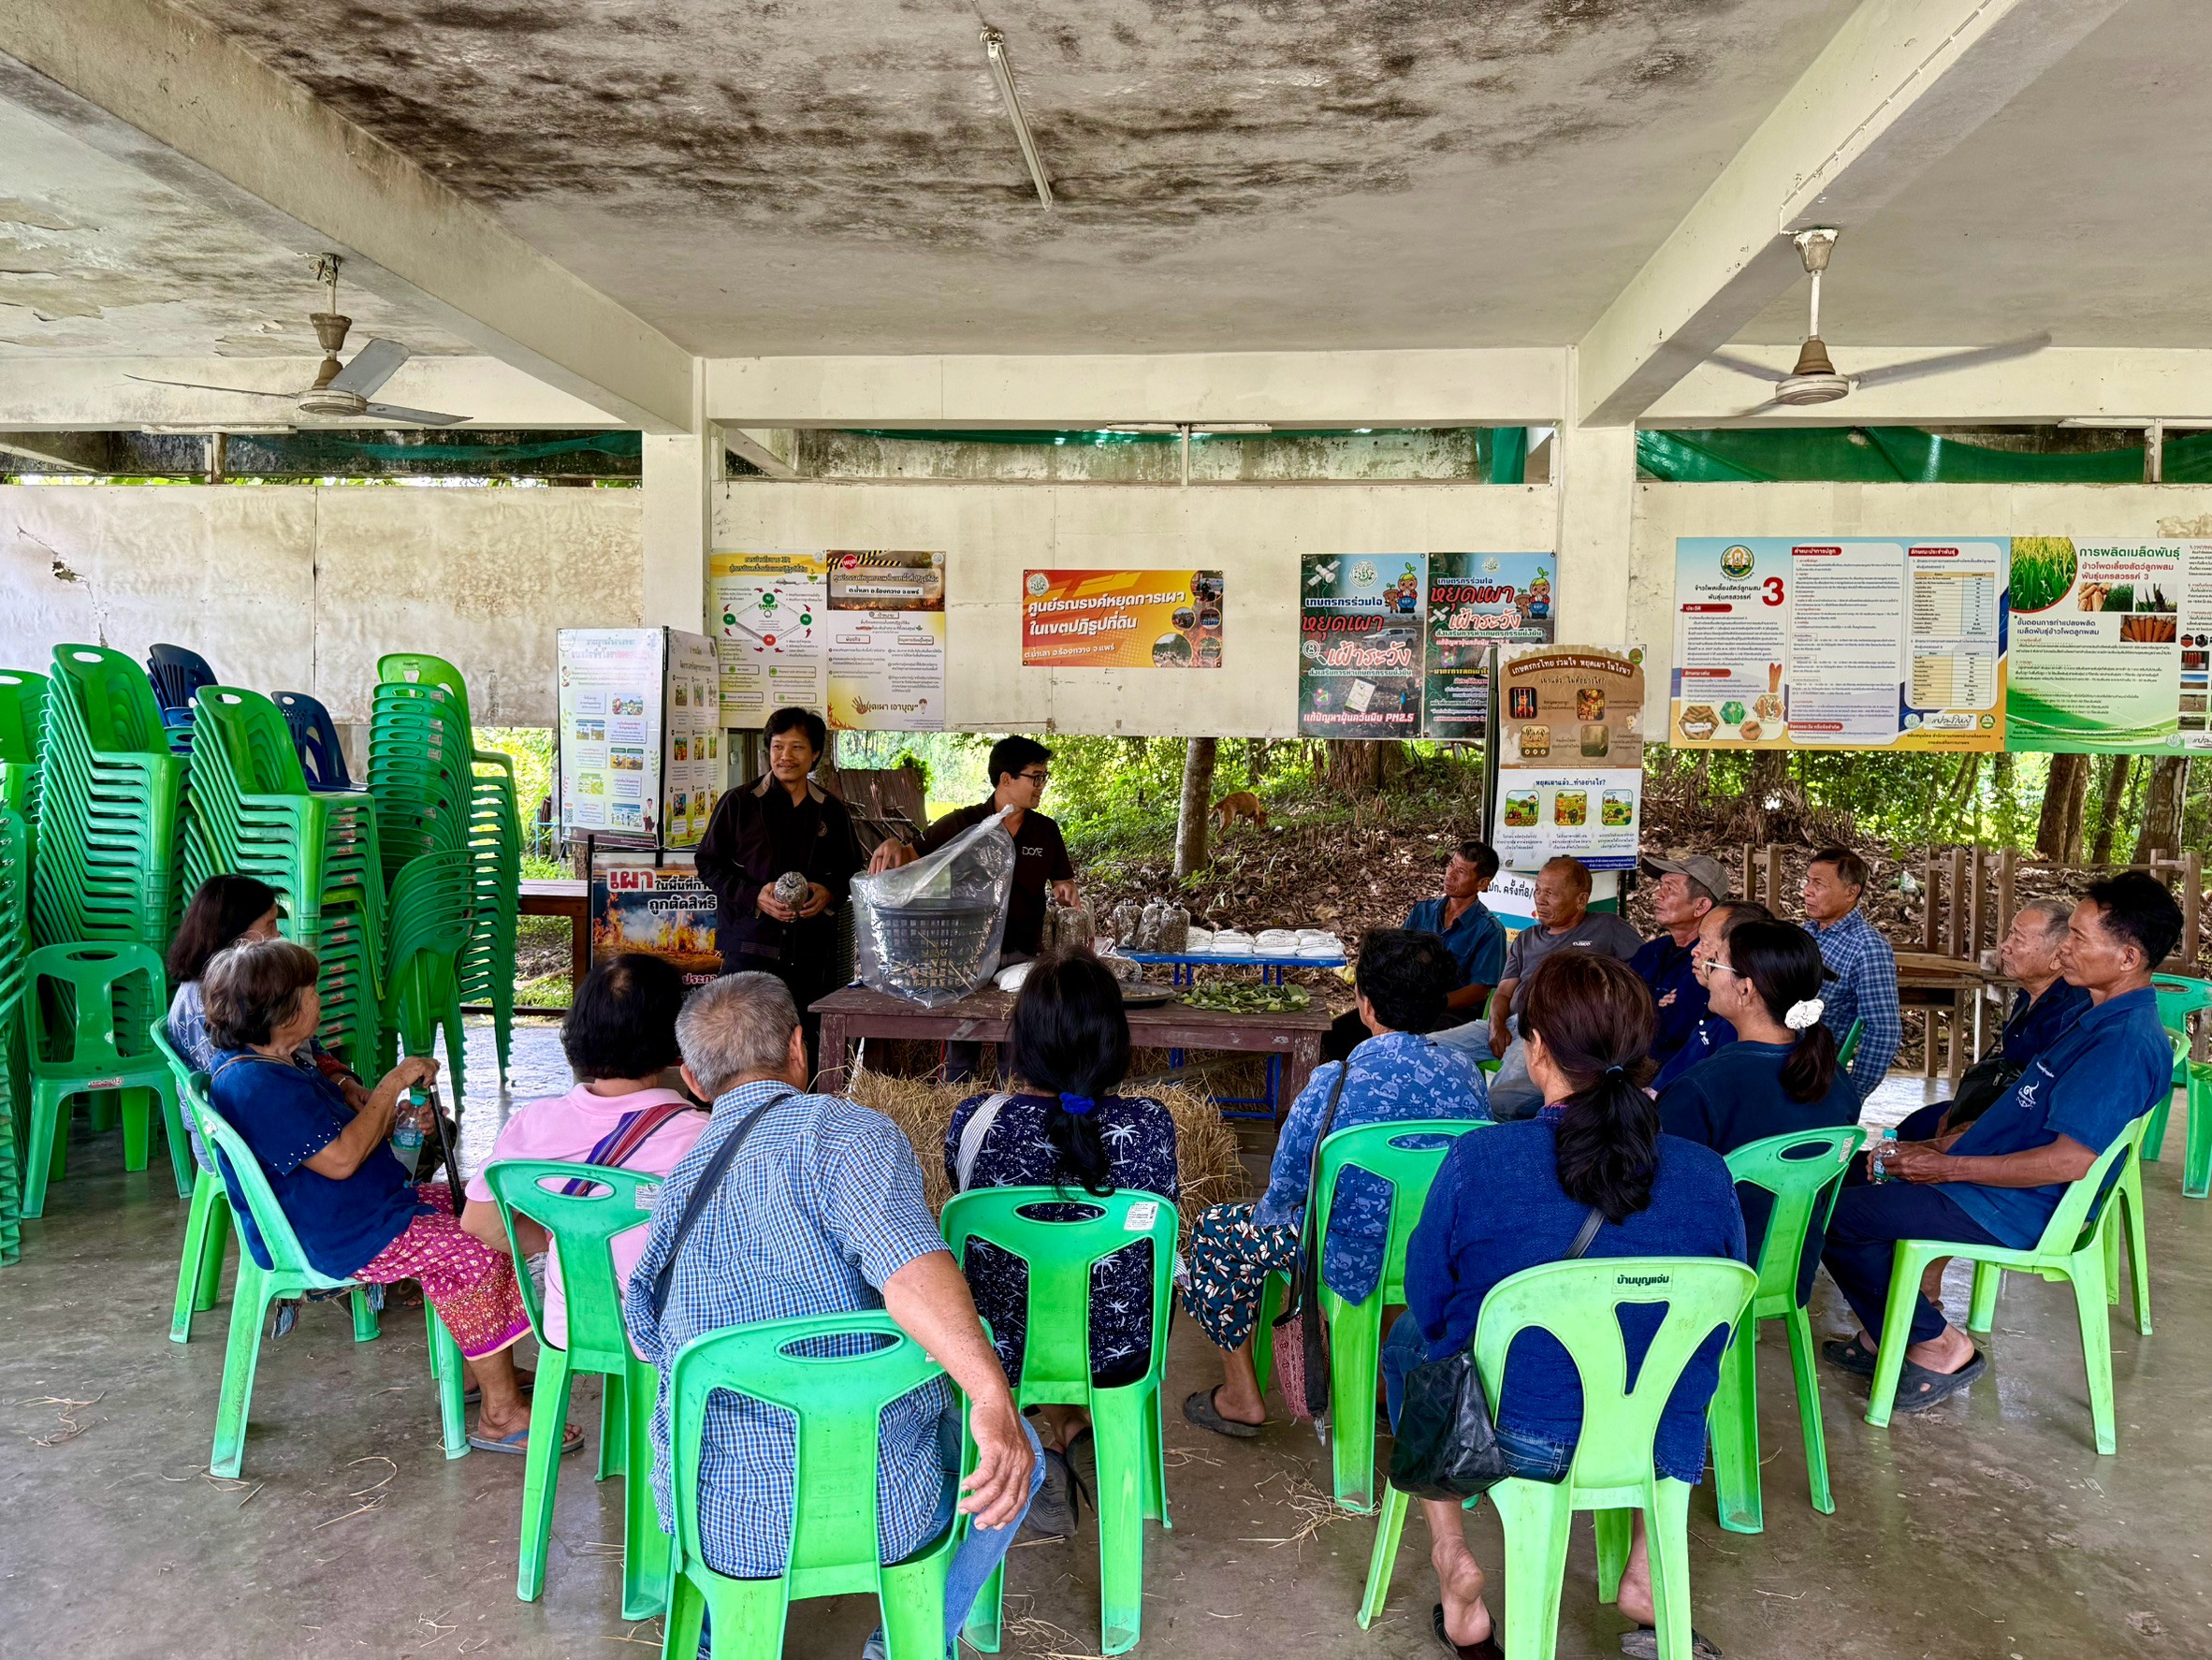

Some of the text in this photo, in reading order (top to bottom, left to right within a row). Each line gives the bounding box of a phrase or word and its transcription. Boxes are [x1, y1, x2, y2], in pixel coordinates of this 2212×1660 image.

[2079, 546, 2180, 561] การผลิตเมล็ดพันธุ์
[2082, 561, 2174, 572] ข้าวโพดเลี้ยงสัตว์ลูกผสม
[1437, 577, 1493, 586] เกษตรกรร่วมใจ
[2082, 573, 2140, 581] พันธุ์นครสวรรค์
[1695, 583, 1761, 592] ข้าวโพดเลี้ยงสัตว์ลูกผสม
[1762, 576, 1785, 606] 3
[1027, 590, 1186, 618] ศูนย์รณรงค์หยุดการเผา
[1305, 596, 1383, 606] เกษตรกรร่วมใจ
[1431, 586, 1515, 612] หยุดเผา
[1708, 593, 1752, 602] พันธุ์นครสวรรค์
[1030, 610, 1138, 636] ในเขตปฏิรูปที่ดิน
[1448, 607, 1522, 630] เฝ้าระวัง
[2017, 618, 2096, 627] ขั้นตอนการทำแปลงผลิต
[1302, 615, 1384, 642] หยุดเผา
[2016, 627, 2100, 637] เมล็ดพันธุ์ข้าวโพดลูกผสม
[1024, 642, 1115, 659] ต.น้ำเลา อ.ร้องกวาง จ.แพร่
[1327, 640, 1412, 666] เฝ้าระวัง
[1511, 657, 1631, 675] เกษตรกรไทย ร่วมใจ หยุดเผา ในไร่นา
[1303, 711, 1415, 724] แก้ปัญหาฝุ่นควันพิษ PM2.5
[609, 869, 654, 890] เผา
[1503, 879, 1534, 899] ครั้งที่8/
[648, 896, 717, 915] ถูกตัดสิทธิ
[682, 973, 719, 984] ประกา
[1616, 1273, 1670, 1288] บ้านบุญแจ่ม
